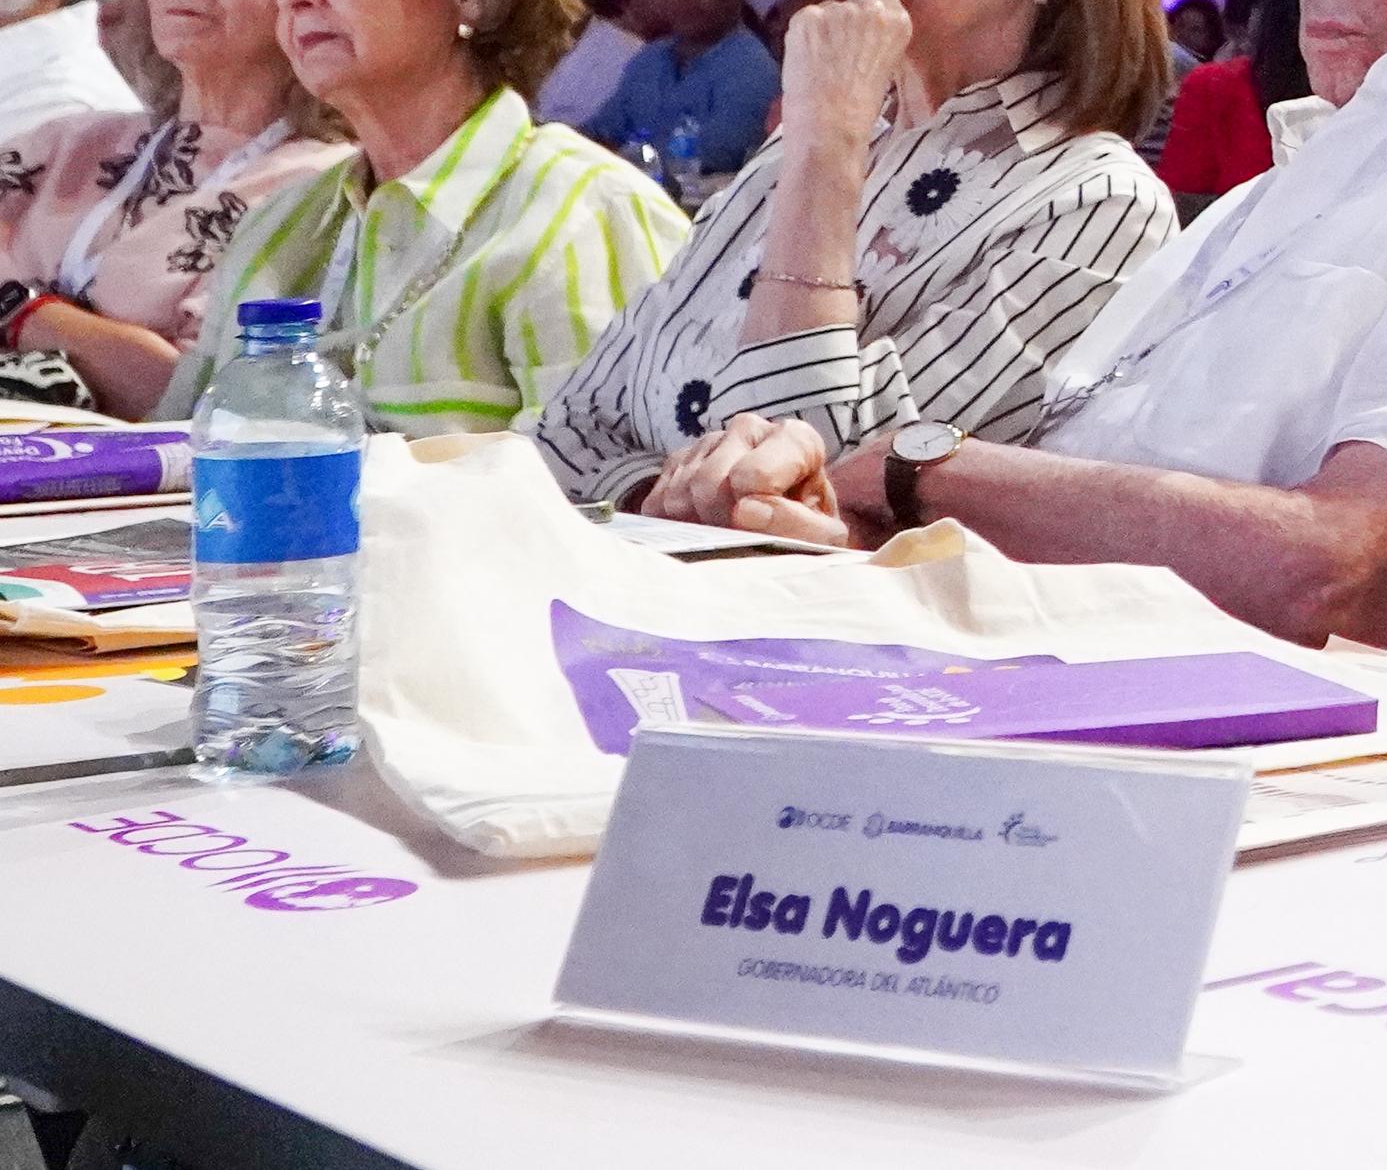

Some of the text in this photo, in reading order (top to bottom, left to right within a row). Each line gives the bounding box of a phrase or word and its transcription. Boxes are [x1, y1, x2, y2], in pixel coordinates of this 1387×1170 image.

[67, 810, 291, 871] OCDE
[699, 873, 1073, 964] Elsa Noguera
[737, 957, 1000, 1005] GOBERNADORA DEL ATLÁNTICO
